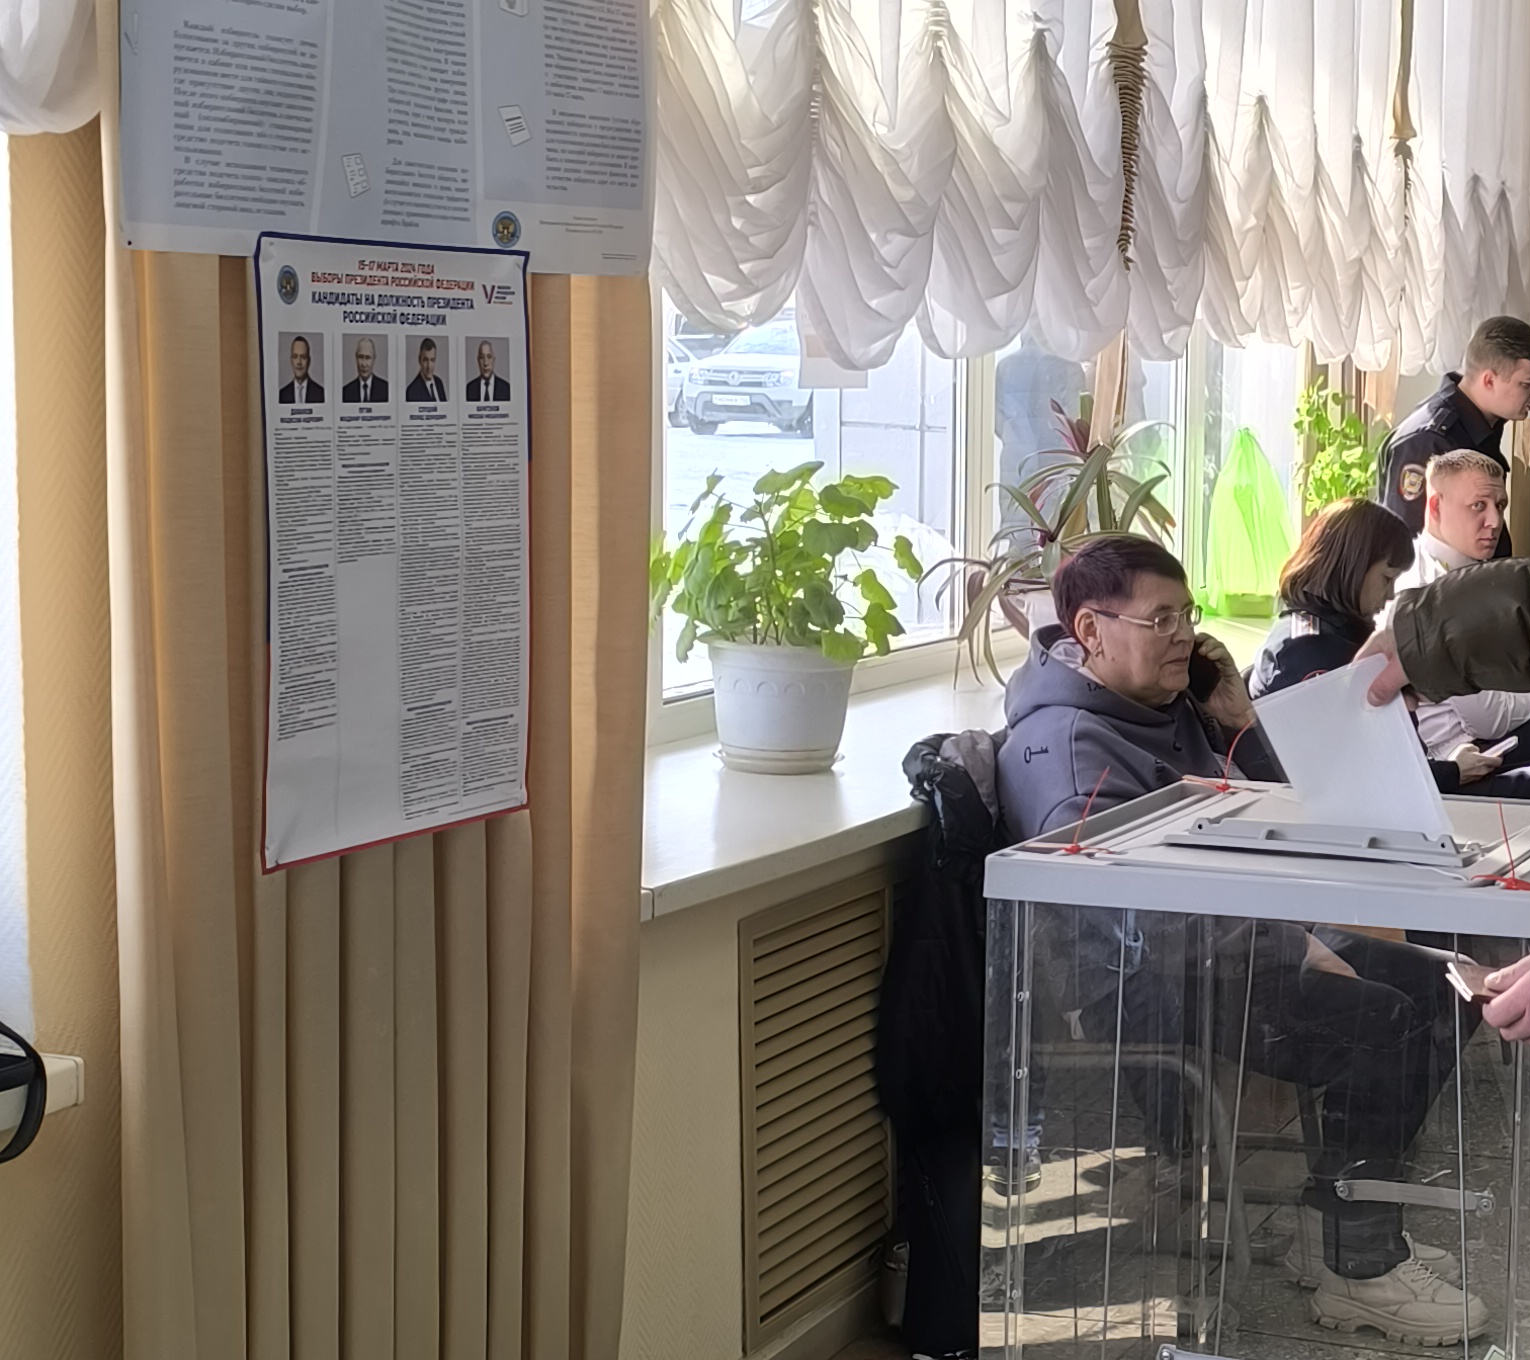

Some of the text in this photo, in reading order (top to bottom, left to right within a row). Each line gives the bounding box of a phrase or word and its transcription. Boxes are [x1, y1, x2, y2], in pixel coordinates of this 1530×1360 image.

[376, 261, 399, 273] МАРТА
[311, 271, 475, 291] ВЫБОРЫ ПРЕЗИДЕНТА РОССИЙСКОЙ ФЕДЕРАЦИИ
[311, 291, 475, 310] КАНДИДАТЫ НА ДОЛЖНОСТЬ ПРЕЗИДЕНТА
[343, 308, 447, 327] РОССИЙСКОЙ ФЕДЕРАЦИИ
